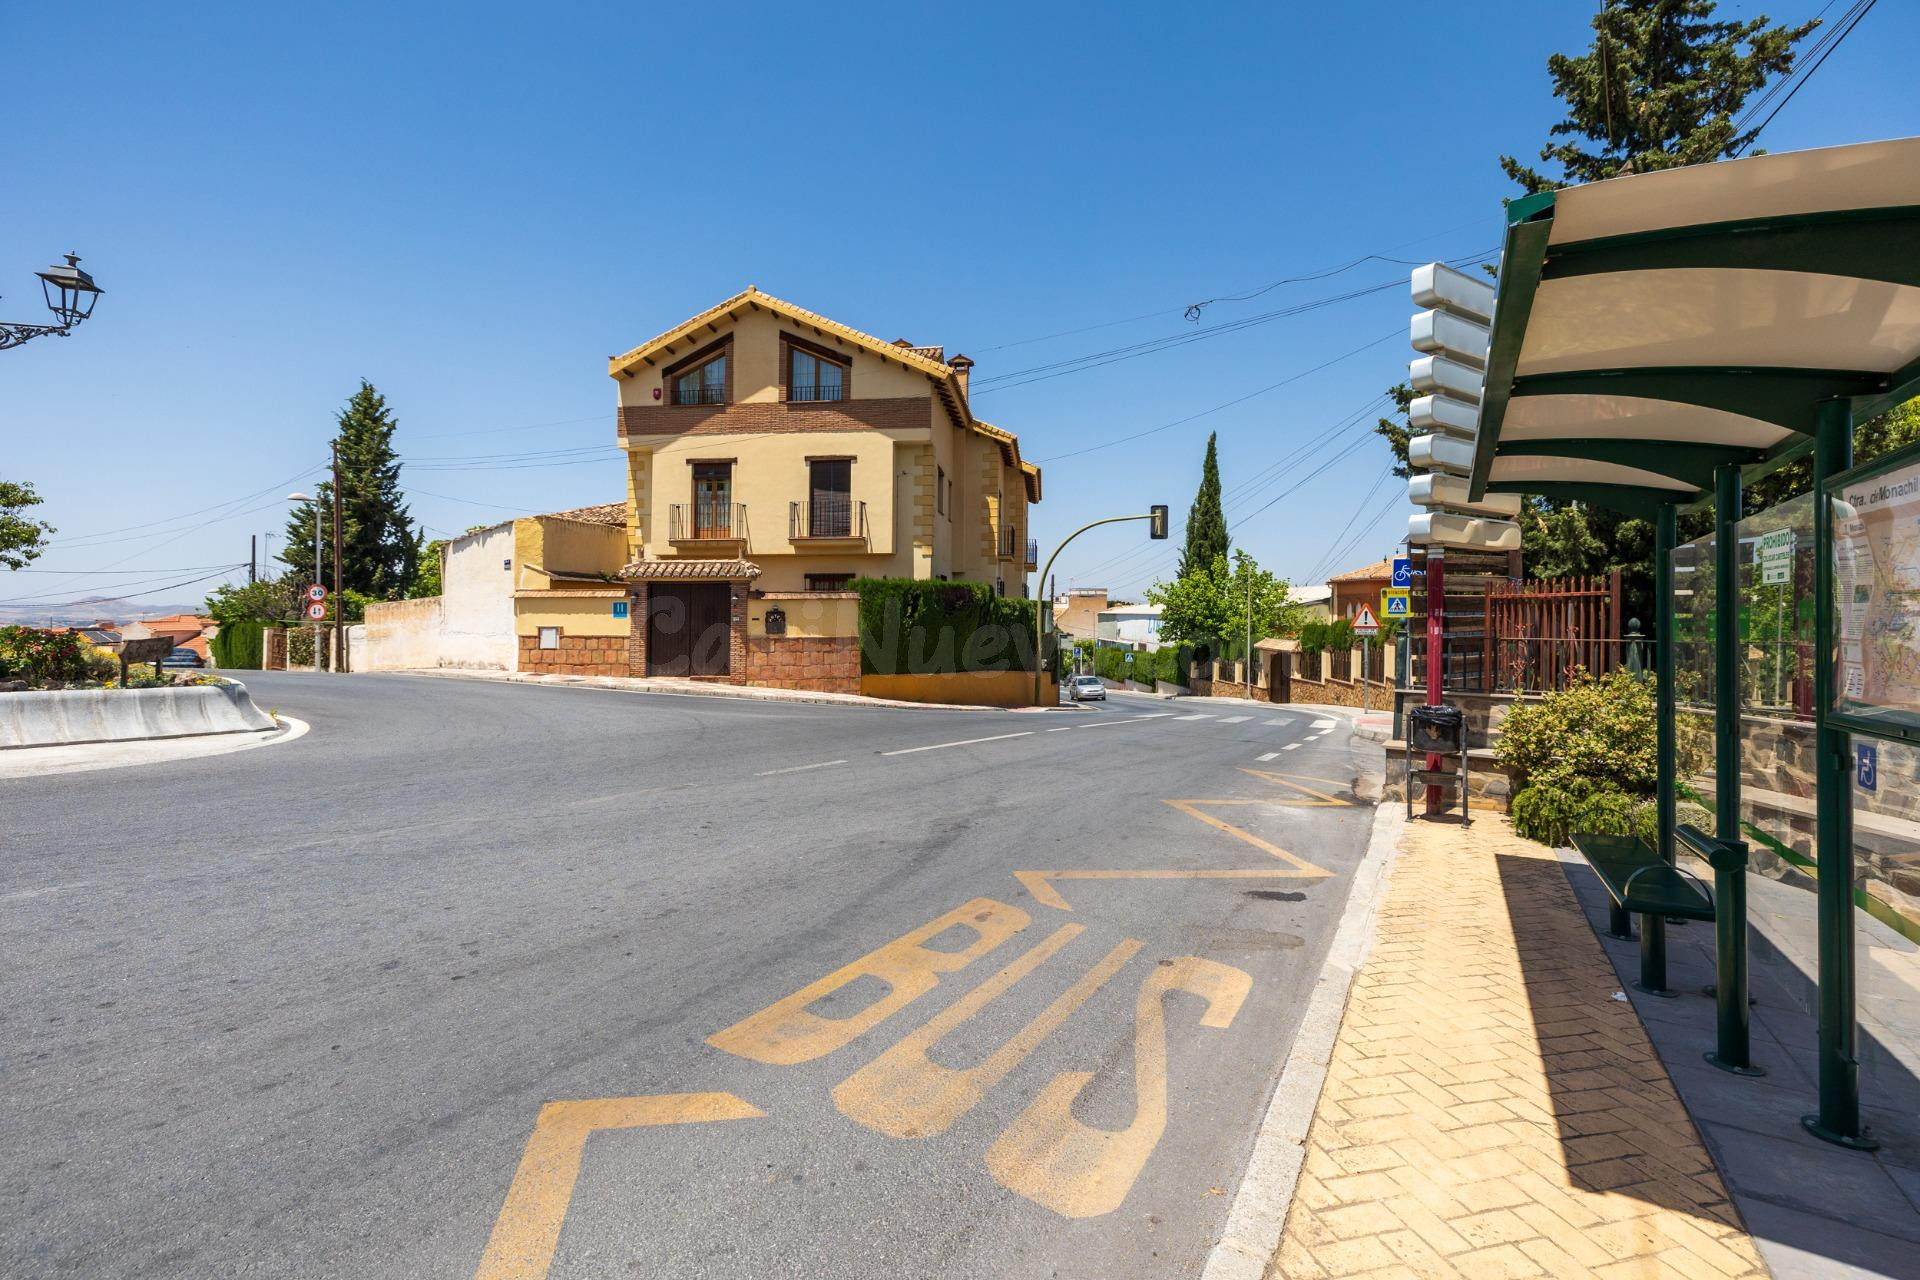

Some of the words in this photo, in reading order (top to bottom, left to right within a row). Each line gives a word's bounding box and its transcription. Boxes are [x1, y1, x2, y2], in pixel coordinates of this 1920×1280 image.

[1879, 474, 1919, 502] Monachil
[1763, 531, 1790, 549] PROHIBIDO
[311, 589, 324, 597] 30
[704, 898, 1253, 1217] BUS
